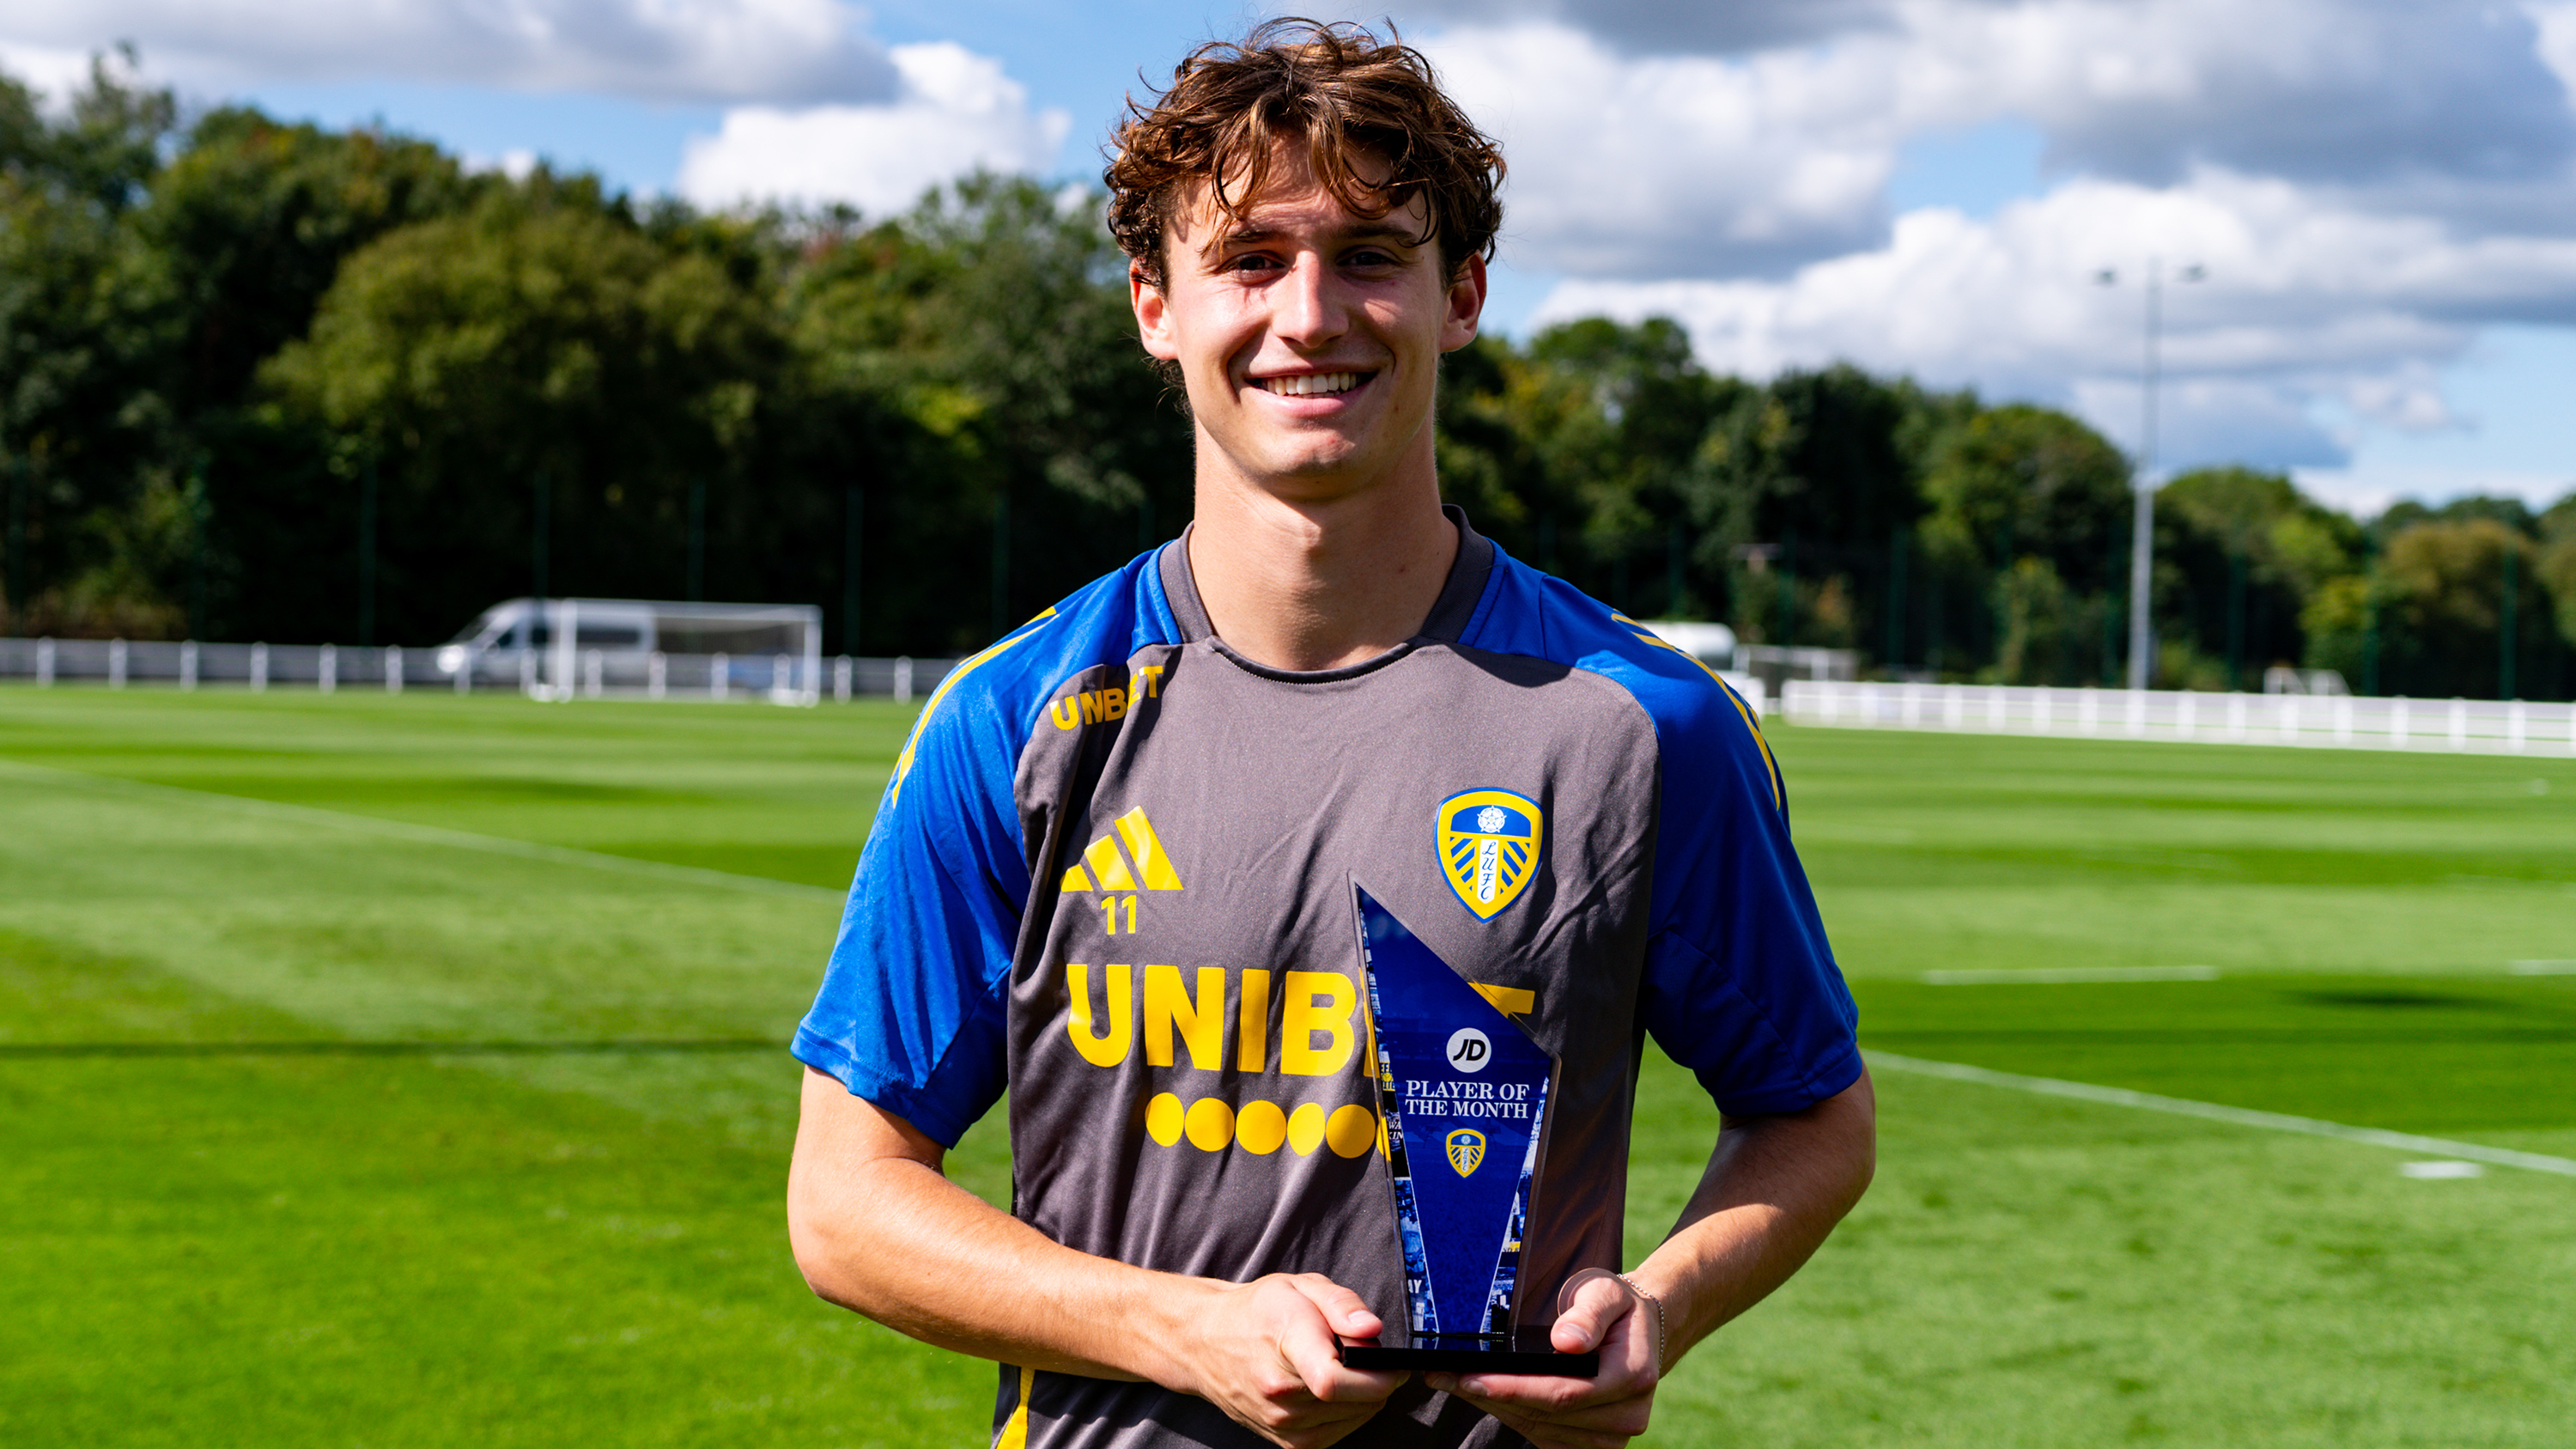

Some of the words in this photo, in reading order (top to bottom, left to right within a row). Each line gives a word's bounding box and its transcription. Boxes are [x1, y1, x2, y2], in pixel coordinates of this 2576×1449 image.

[1480, 842, 1497, 899] LUFC
[1101, 895, 1136, 935] 11
[1066, 964, 1535, 1077] UNIB
[1453, 1038, 1486, 1061] JD
[1406, 1080, 1495, 1099] PLAYER
[1499, 1083, 1530, 1101] OF
[1405, 1099, 1448, 1116] THE
[1452, 1100, 1529, 1119] MONTH
